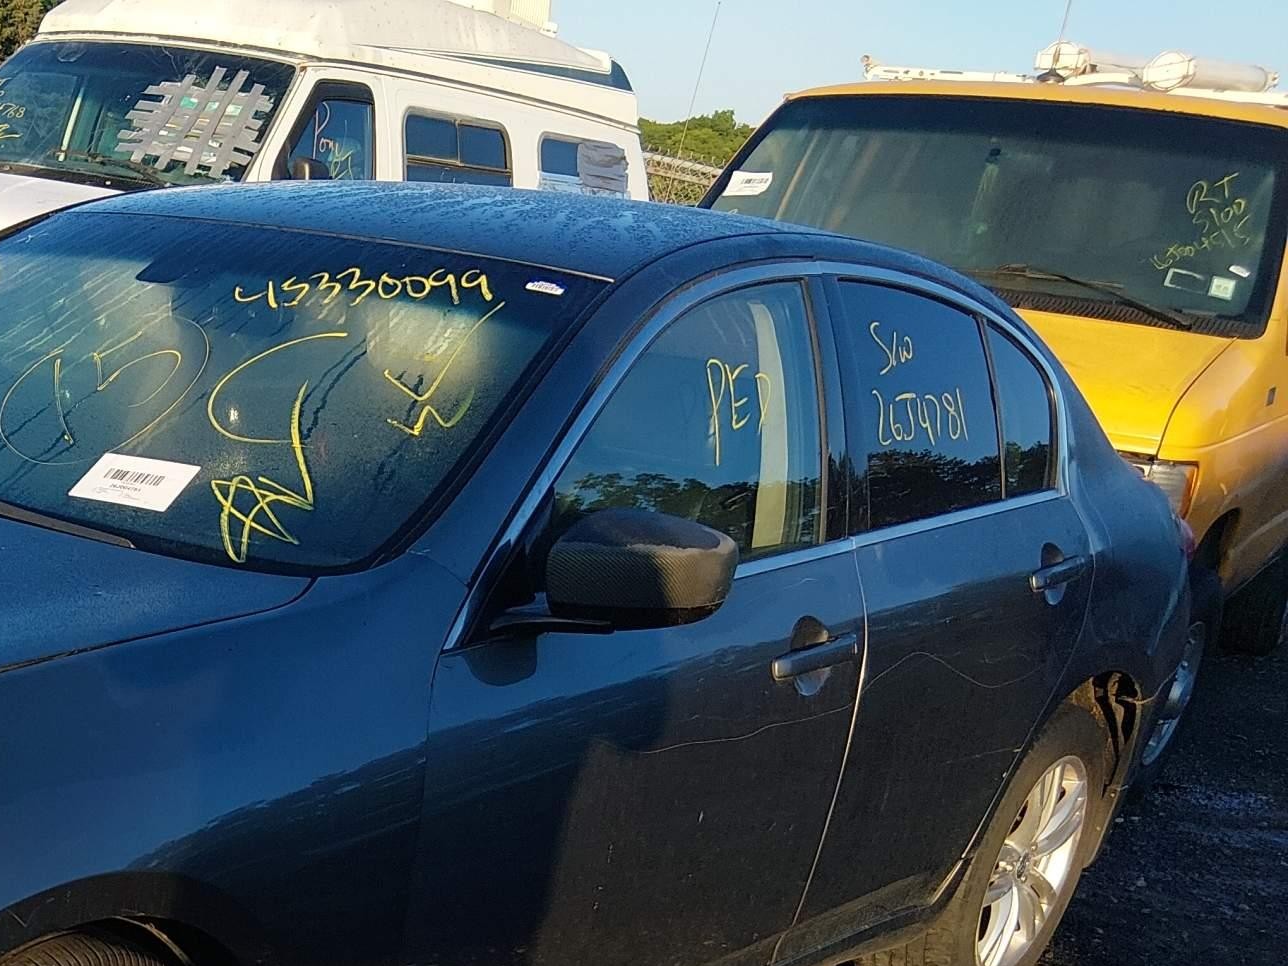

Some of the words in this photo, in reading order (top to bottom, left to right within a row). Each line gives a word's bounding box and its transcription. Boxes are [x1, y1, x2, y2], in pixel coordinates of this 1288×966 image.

[235, 268, 494, 308] 45330099
[706, 358, 773, 466] PED
[872, 387, 969, 446] 26J4781
